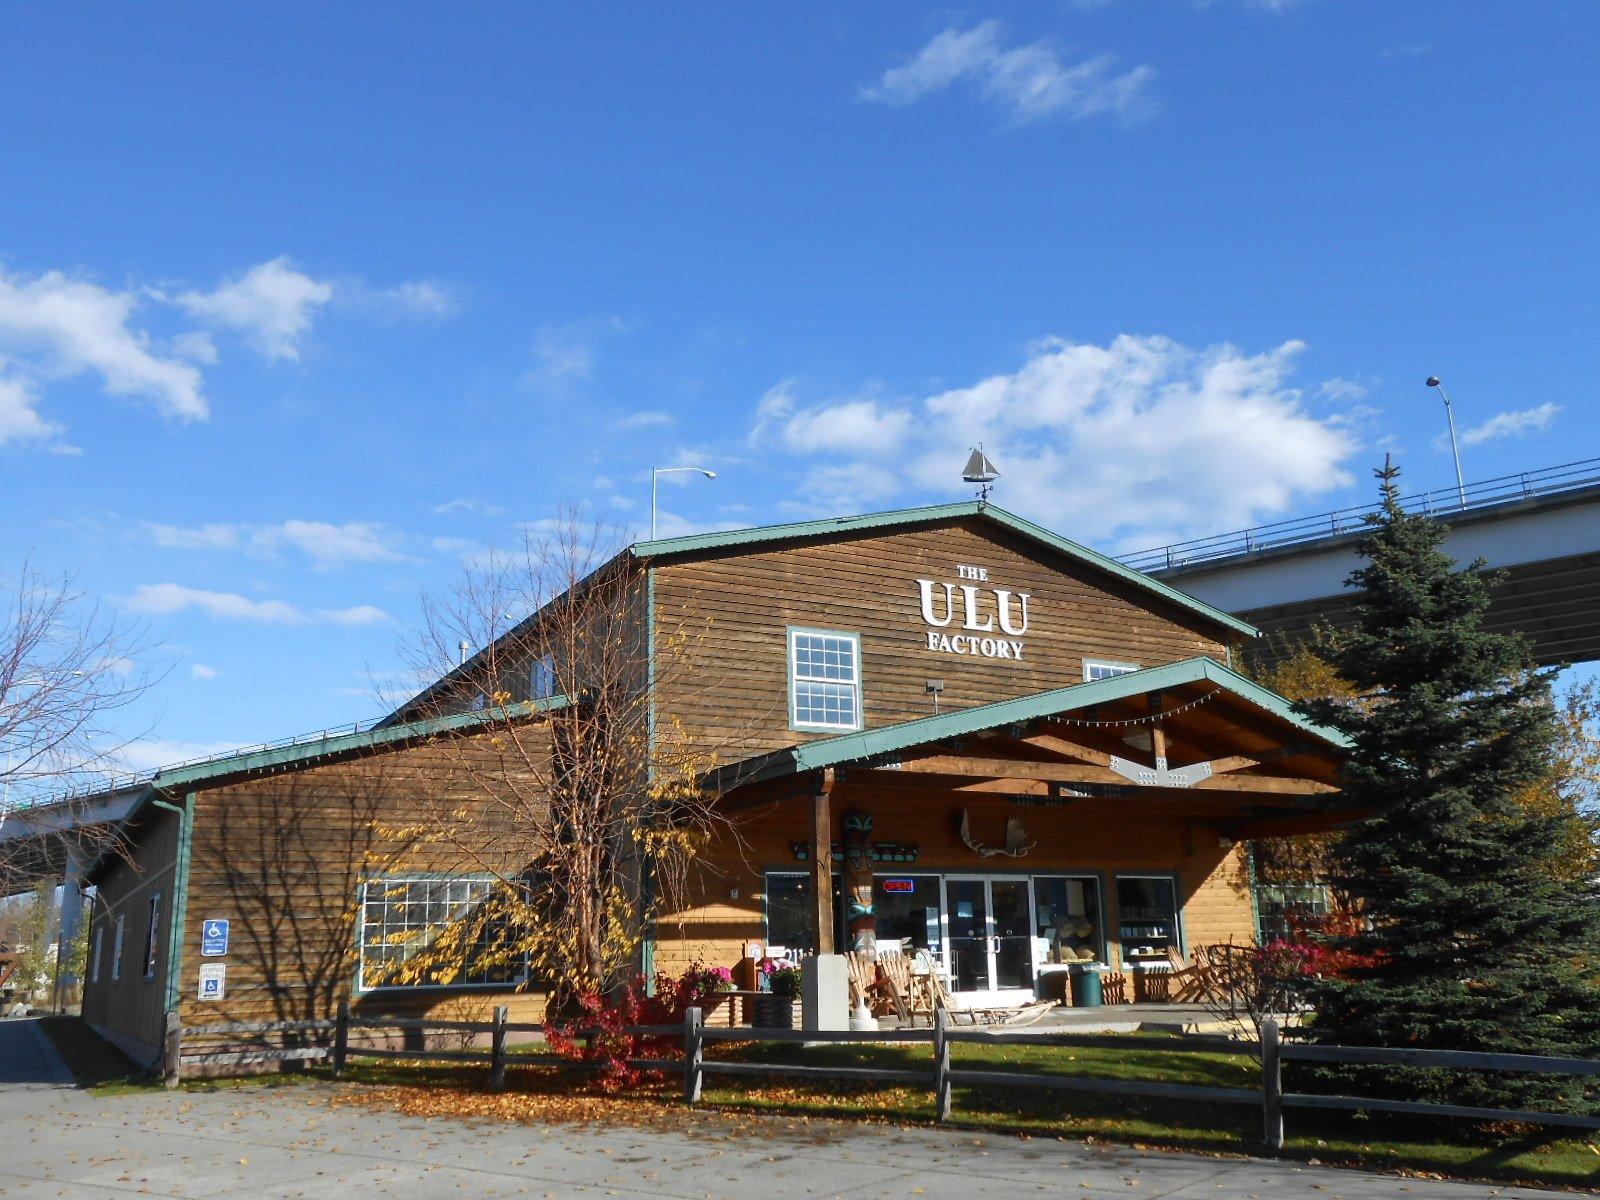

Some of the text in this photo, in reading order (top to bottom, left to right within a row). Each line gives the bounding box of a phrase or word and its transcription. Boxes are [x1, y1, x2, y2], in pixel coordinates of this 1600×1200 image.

[956, 565, 988, 582] THE
[915, 579, 1031, 636] ULU
[927, 632, 1024, 660] FACTORY
[882, 881, 911, 891] OPEN
